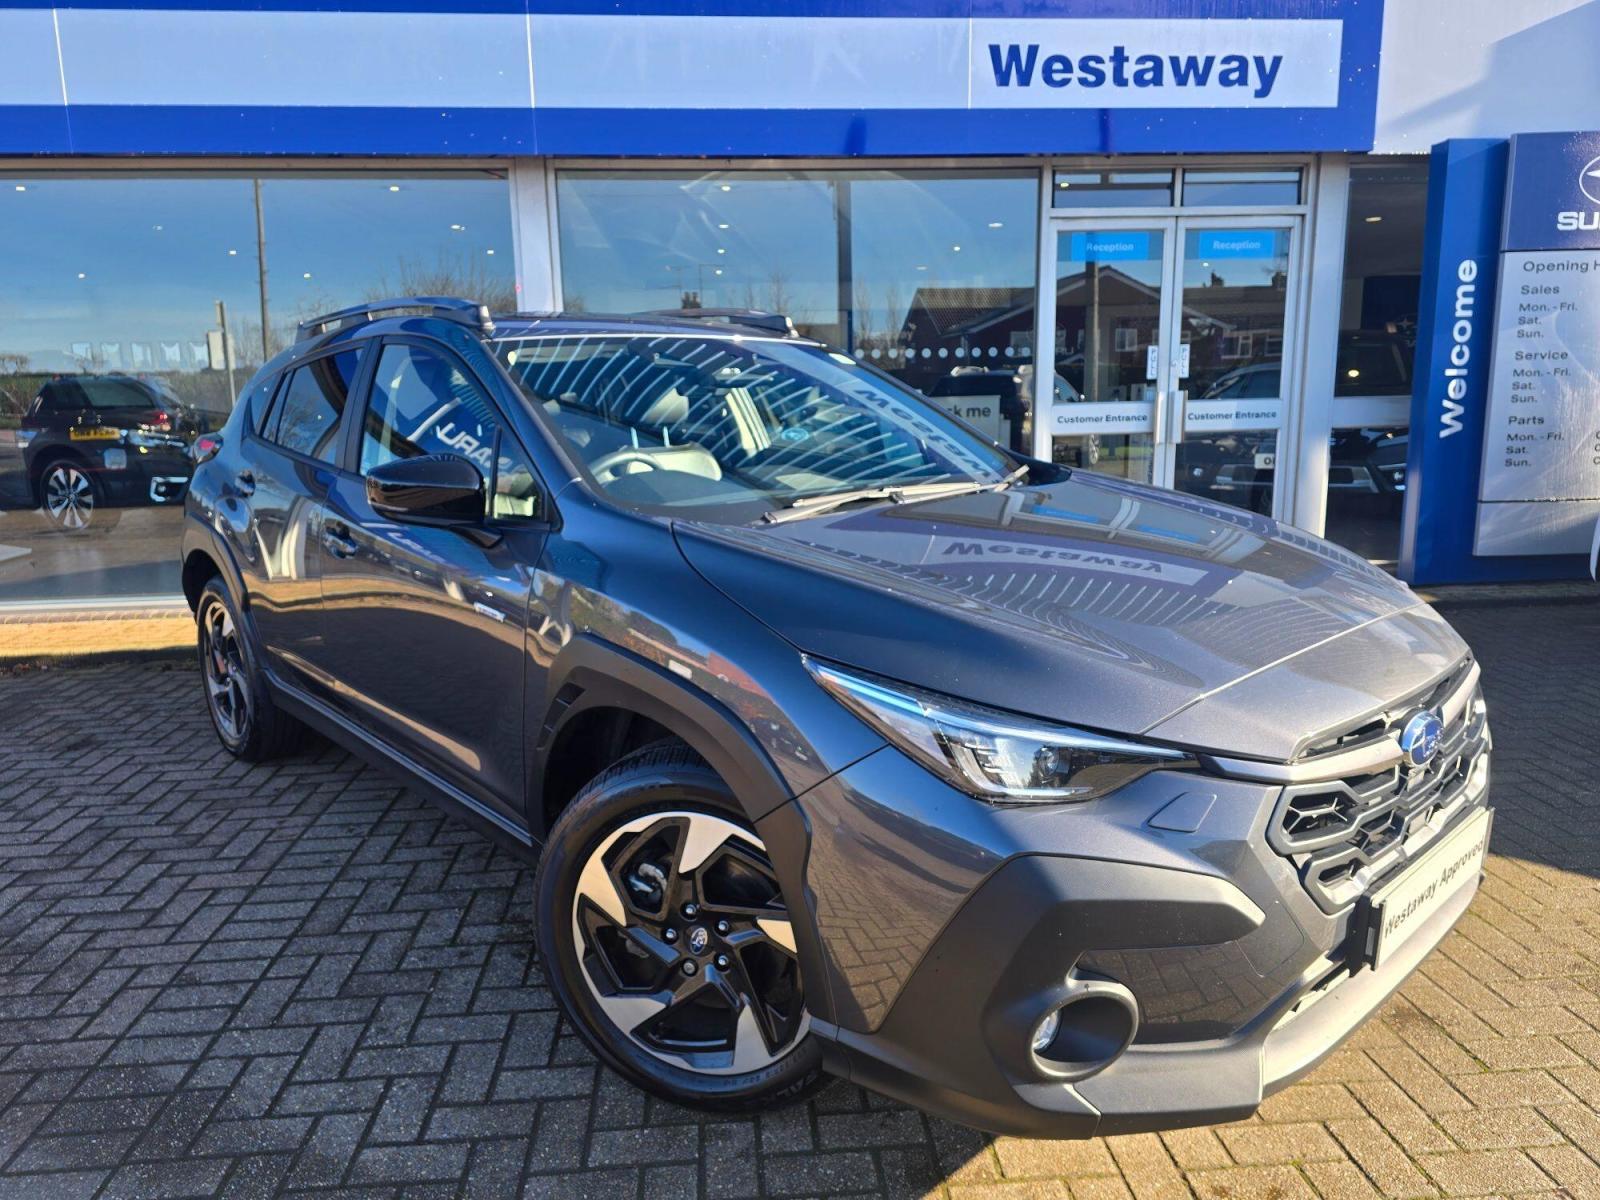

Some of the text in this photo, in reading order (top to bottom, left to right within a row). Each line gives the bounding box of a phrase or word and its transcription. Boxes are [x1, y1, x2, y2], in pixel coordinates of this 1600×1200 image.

[988, 44, 1284, 98] Westaway
[1557, 211, 1600, 231] SU
[1086, 242, 1135, 252] Reception
[1212, 239, 1261, 250] Reception
[1523, 260, 1589, 274] Opening
[1520, 284, 1560, 295] Sales
[1519, 303, 1550, 312] Mon.
[1560, 302, 1578, 311] Fri.
[1518, 316, 1542, 325] Sat.
[1517, 329, 1544, 338] Sun.
[1439, 259, 1478, 438] Welcome
[1515, 350, 1568, 361] Service
[1512, 368, 1544, 377] Mon.
[1553, 367, 1571, 377] Fri.
[1511, 381, 1535, 391] Sat.
[1511, 394, 1538, 403] Sun.
[966, 407, 992, 417] me
[1187, 410, 1277, 421] Customer Entrance
[1057, 414, 1148, 424] Customer Entrance
[1508, 415, 1545, 425] Parts
[1506, 433, 1537, 441] Mon.
[1546, 432, 1565, 441] Fri.
[1505, 445, 1529, 454] Sat.
[1504, 458, 1532, 467] Sun.
[1384, 834, 1485, 938] Westaway Approved
